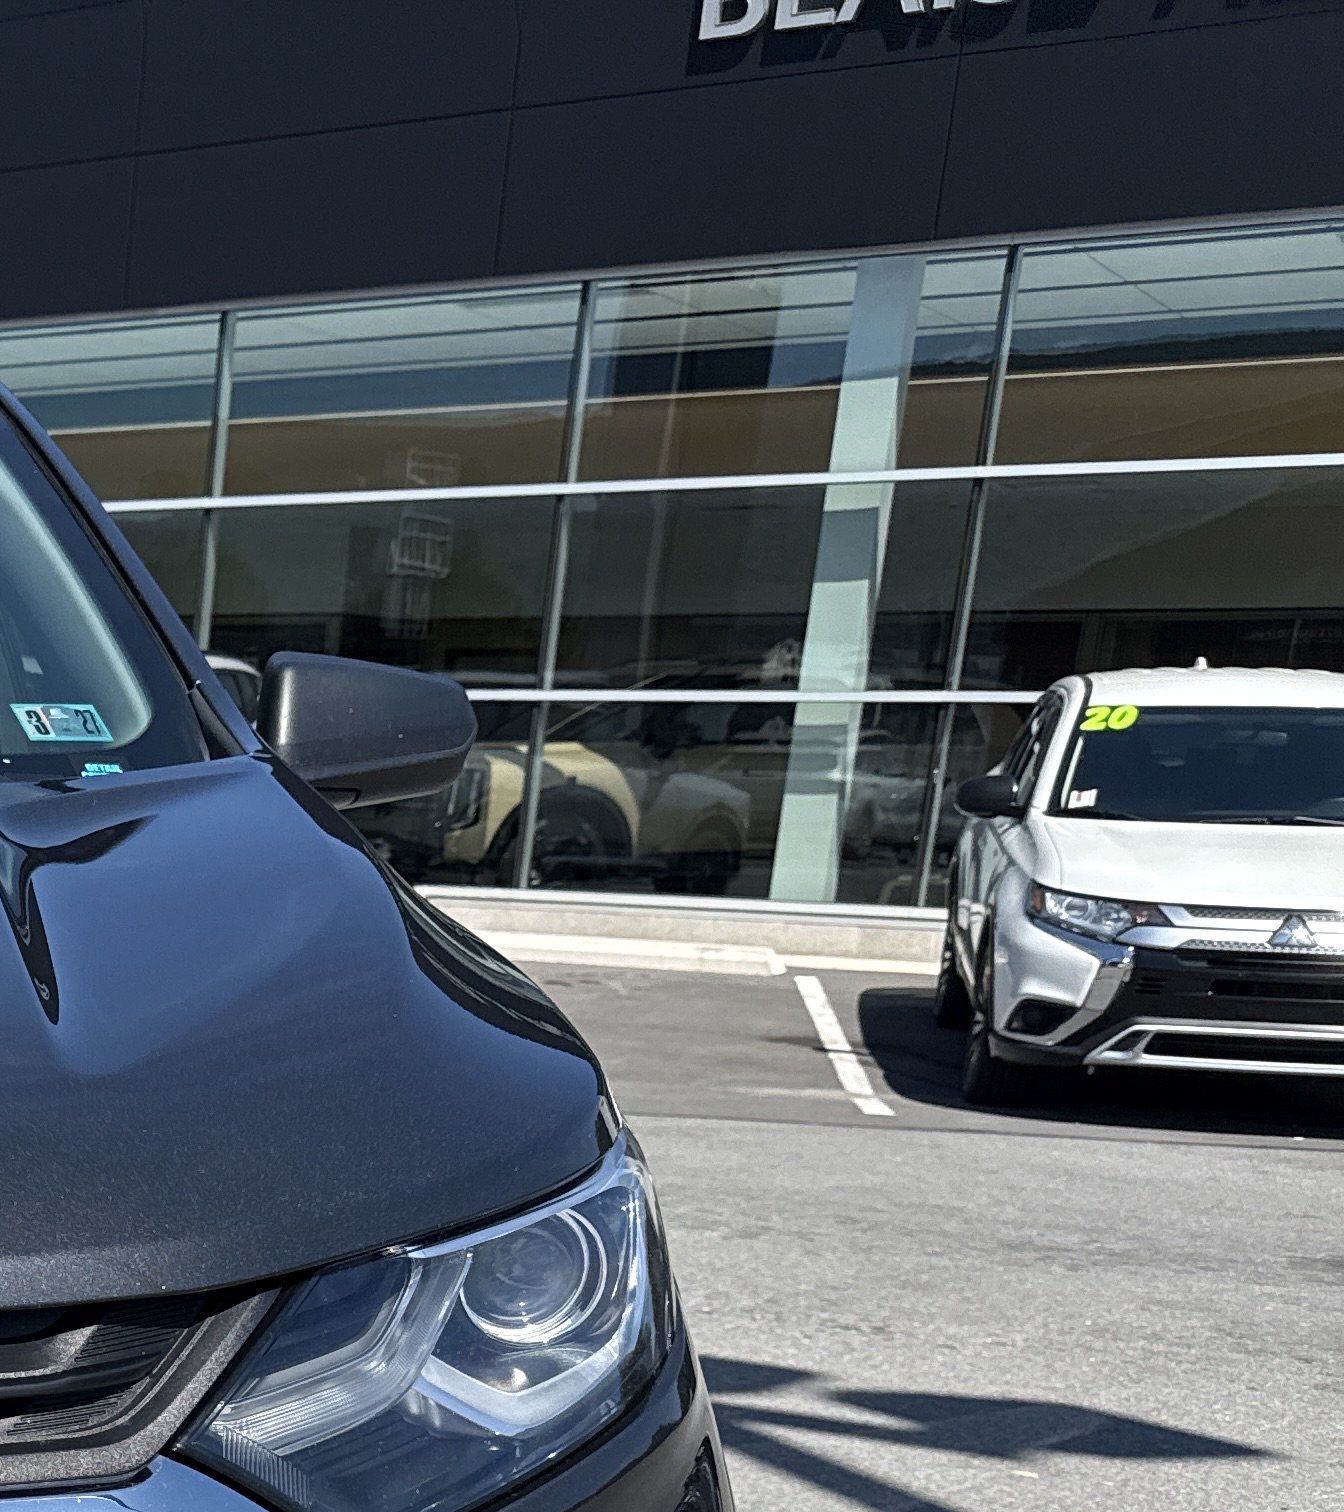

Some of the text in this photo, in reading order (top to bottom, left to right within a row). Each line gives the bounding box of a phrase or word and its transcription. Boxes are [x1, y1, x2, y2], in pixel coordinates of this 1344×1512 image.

[25, 709, 101, 735] 3 27
[1079, 704, 1139, 731] 20
